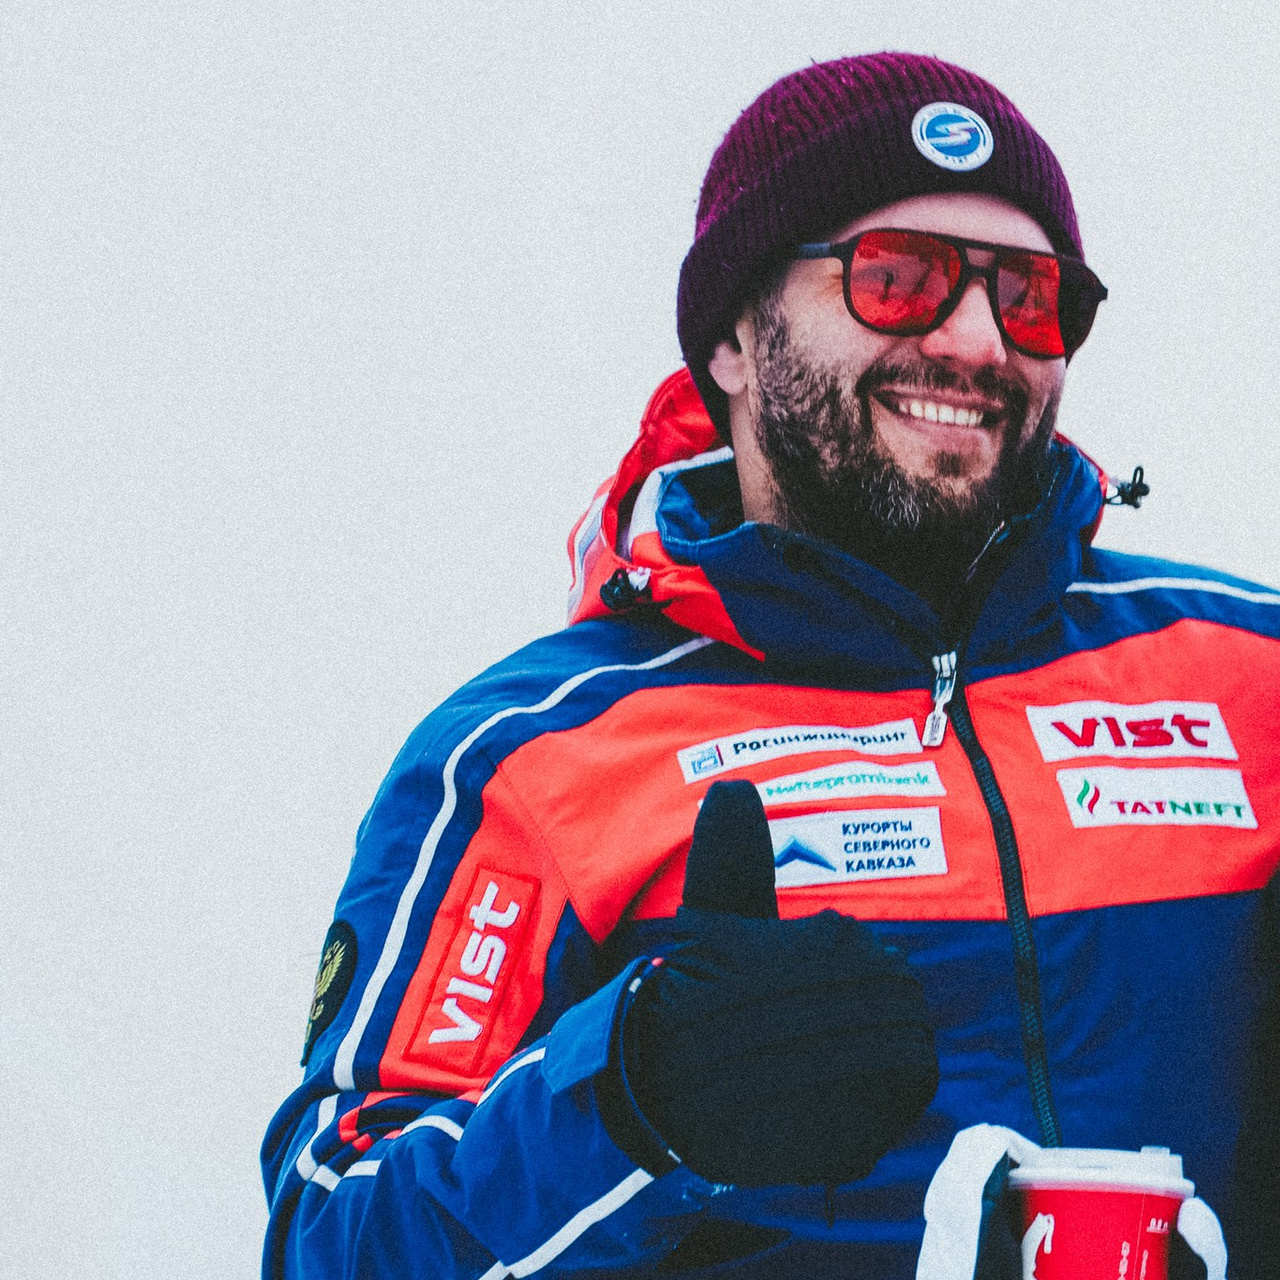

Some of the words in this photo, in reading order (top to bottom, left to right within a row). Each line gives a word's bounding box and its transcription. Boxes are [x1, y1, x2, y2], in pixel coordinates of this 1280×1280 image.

[1110, 800, 1245, 819] TATNEFT
[842, 820, 912, 835] КУРОРТЫ
[843, 837, 931, 853] СЕВЕРНОГО
[845, 856, 916, 873] КАВКАЗА
